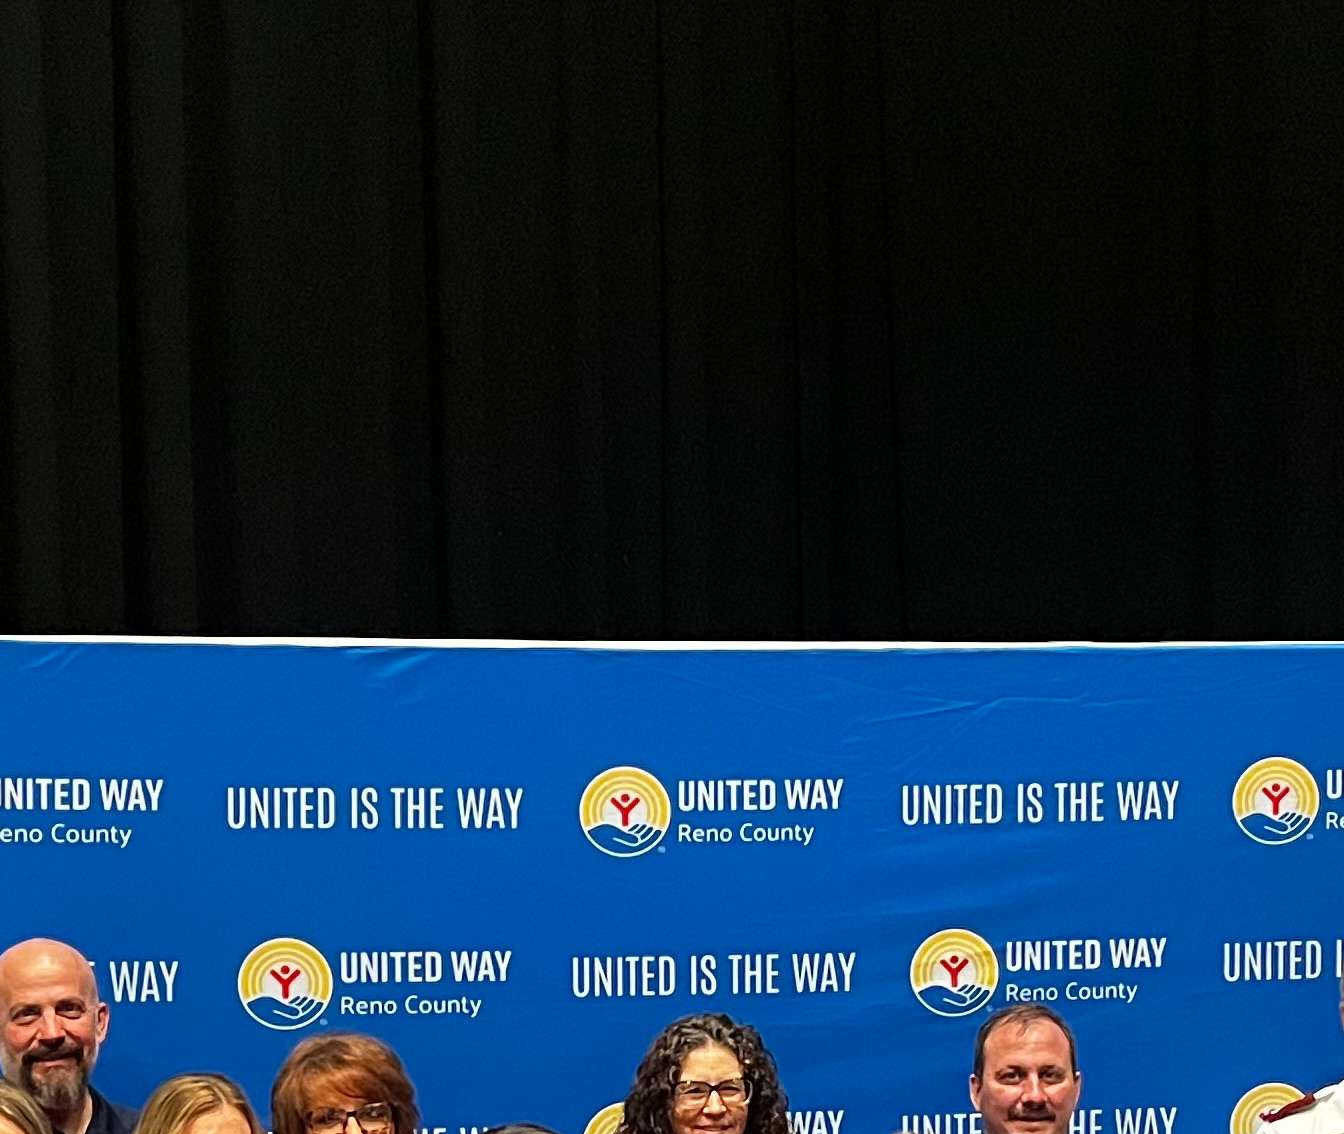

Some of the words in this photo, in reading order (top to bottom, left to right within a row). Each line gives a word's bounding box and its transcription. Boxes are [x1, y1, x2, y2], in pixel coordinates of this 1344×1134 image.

[99, 778, 164, 812] WAY
[227, 787, 336, 830] UNITED
[351, 787, 379, 830] IS
[390, 787, 444, 829] THE
[456, 787, 523, 829] WAY
[678, 779, 776, 812] UNITED
[784, 778, 844, 810] WAY
[902, 783, 1003, 826] UNITED
[1017, 782, 1043, 823] IS
[1054, 782, 1105, 823] THE
[1116, 780, 1179, 821] WAY
[51, 823, 132, 849] County
[678, 823, 733, 843] Reno
[739, 822, 815, 846] County
[340, 951, 443, 984] UNITED
[450, 950, 512, 982] WAY
[1005, 939, 1101, 972] UNITED
[1109, 937, 1167, 969] WAY
[1223, 940, 1322, 982] UNITED
[109, 960, 179, 1003] WAY
[572, 955, 676, 998] UNITED
[690, 954, 717, 996] IS
[727, 953, 780, 995] THE
[792, 952, 856, 993] WAY
[340, 996, 398, 1015] Reno
[404, 994, 482, 1018] County
[1006, 983, 1059, 1002] Reno
[1065, 981, 1138, 1004] County
